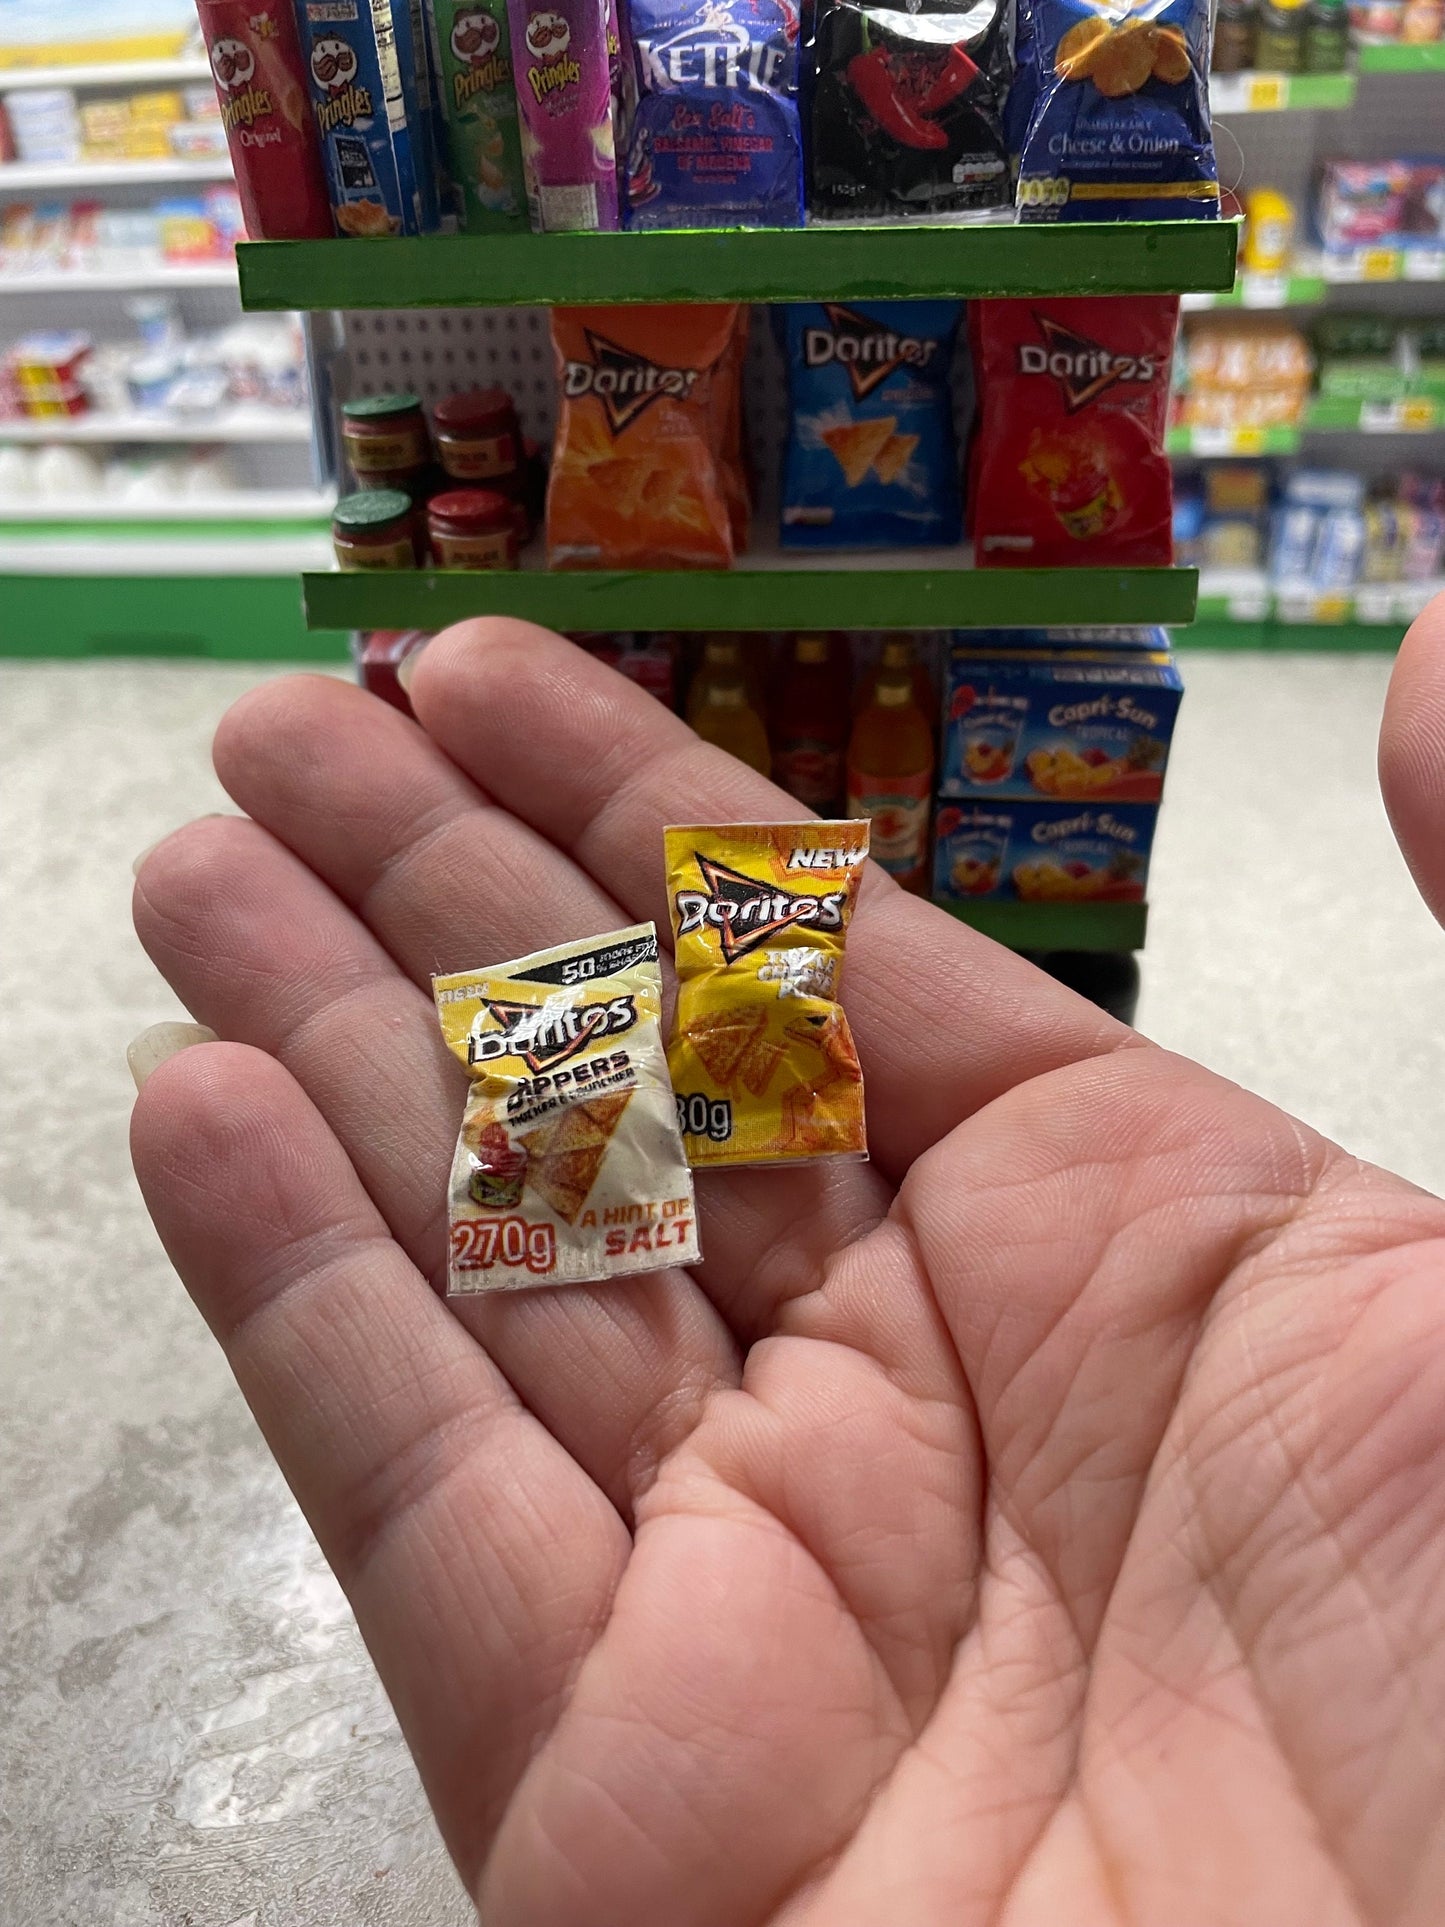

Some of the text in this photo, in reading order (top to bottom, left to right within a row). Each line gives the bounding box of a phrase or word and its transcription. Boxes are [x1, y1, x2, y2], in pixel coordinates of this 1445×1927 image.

[528, 53, 581, 104] Pringles
[221, 84, 273, 131] Pringles
[316, 85, 373, 139] Pringles
[239, 128, 283, 149] Original
[720, 136, 774, 152] VINEGAR
[1048, 133, 1179, 154] Cheese & Onion
[806, 330, 936, 365] Doritos
[1020, 345, 1156, 382] Doritos
[1048, 694, 1159, 728] Capri-Sun
[1031, 812, 1136, 844] Capri-Sun
[788, 848, 867, 869] NEW
[677, 891, 847, 931] Doritos
[561, 958, 596, 984] 50
[471, 995, 640, 1062] Doritos
[580, 1199, 691, 1228] A HINT OF
[452, 1218, 555, 1273] 270g
[604, 1222, 696, 1256] SALT
